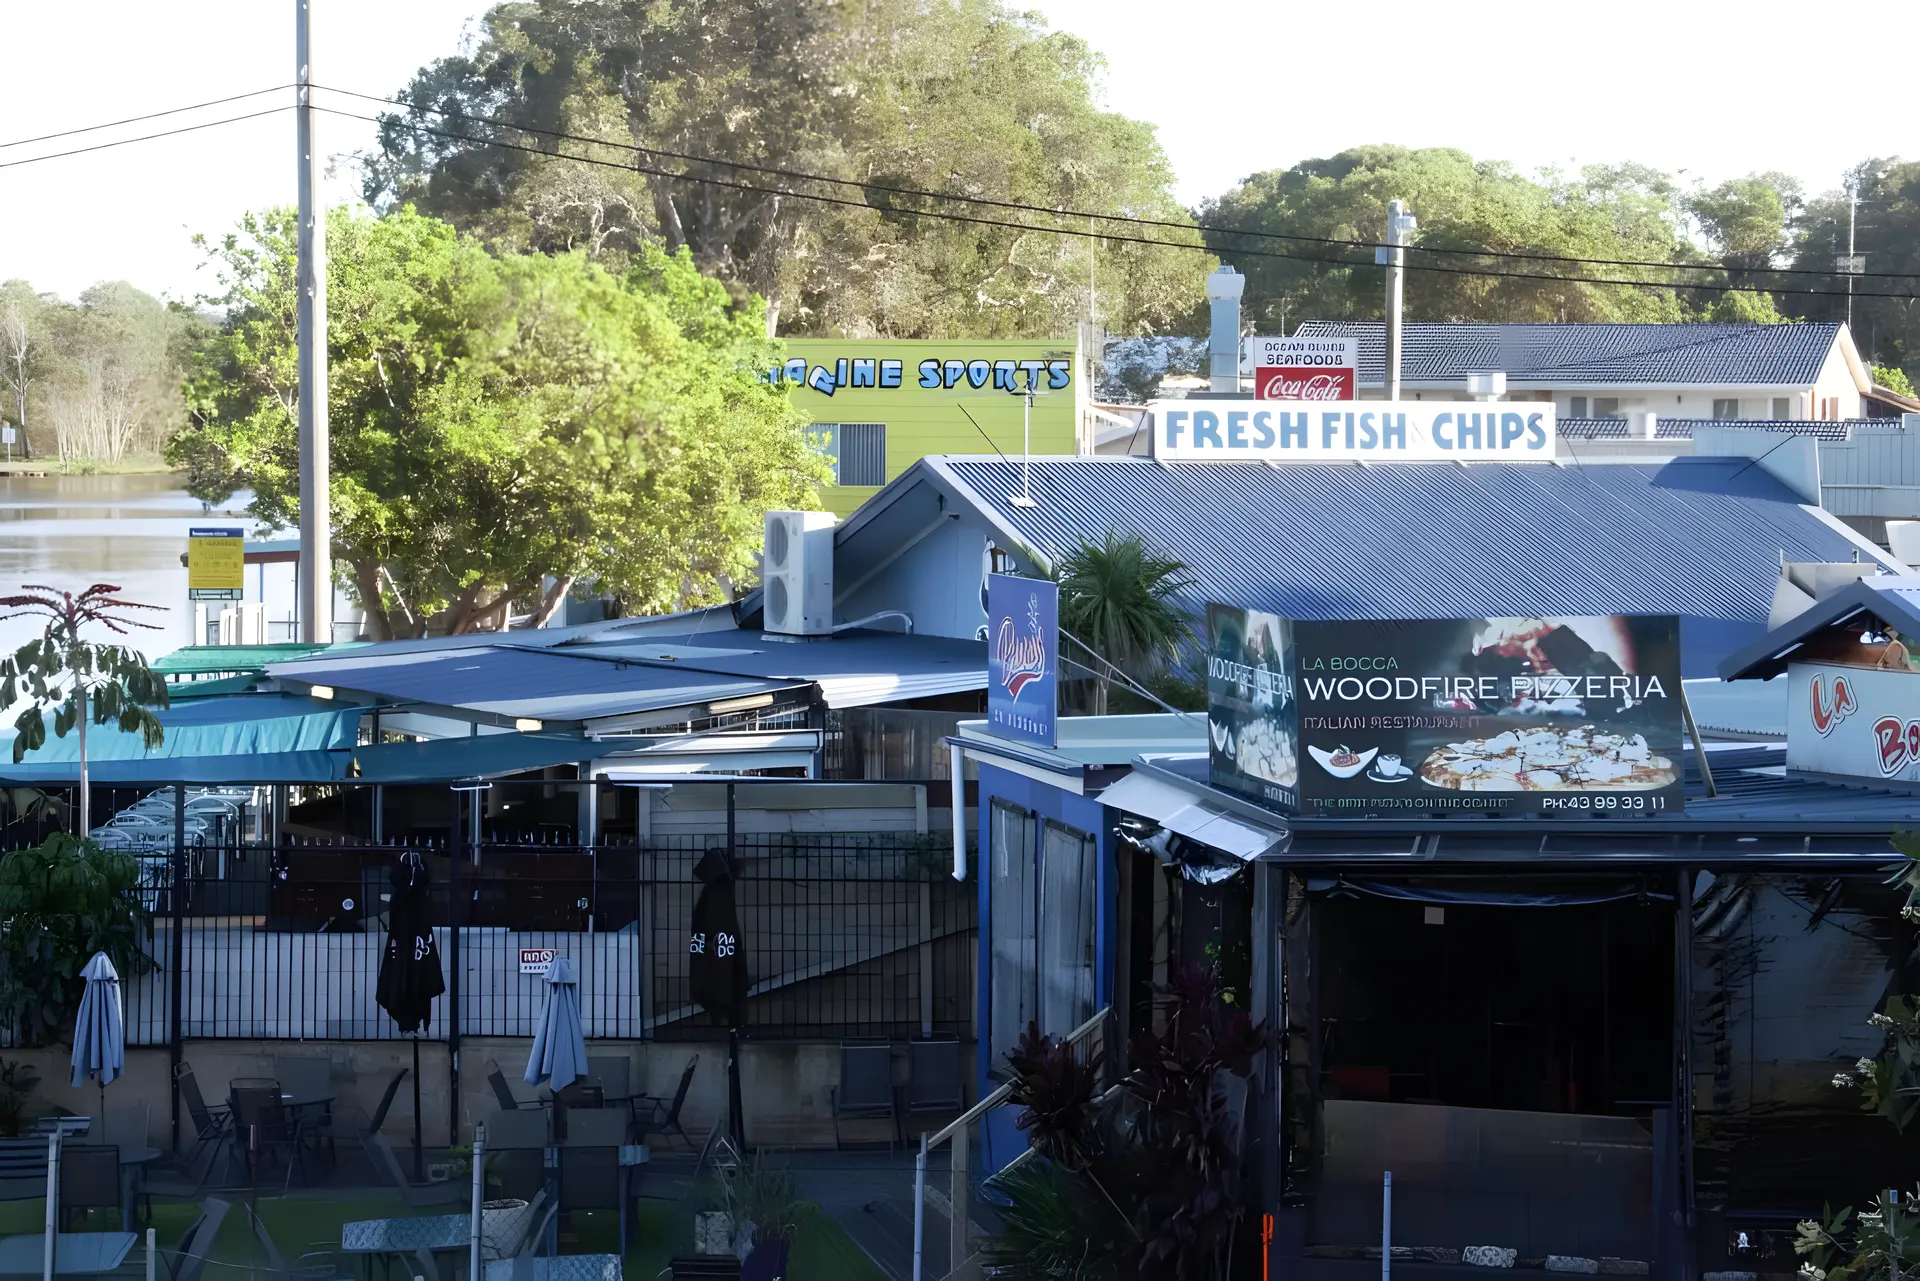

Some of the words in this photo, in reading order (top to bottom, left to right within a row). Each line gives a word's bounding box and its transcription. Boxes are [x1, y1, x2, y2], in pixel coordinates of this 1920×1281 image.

[1266, 354, 1344, 366] SEAFOODS
[918, 358, 1071, 393] SPORTS
[1166, 411, 1308, 449] FRESH
[1321, 412, 1407, 449] FISH
[1431, 412, 1547, 451] CHIPS
[1302, 657, 1325, 670] LA
[1330, 656, 1399, 671] BOCCA
[1303, 676, 1499, 701] WOODFIRE
[1510, 675, 1668, 699] PIZZERIA
[1303, 715, 1366, 730] ITALIAN
